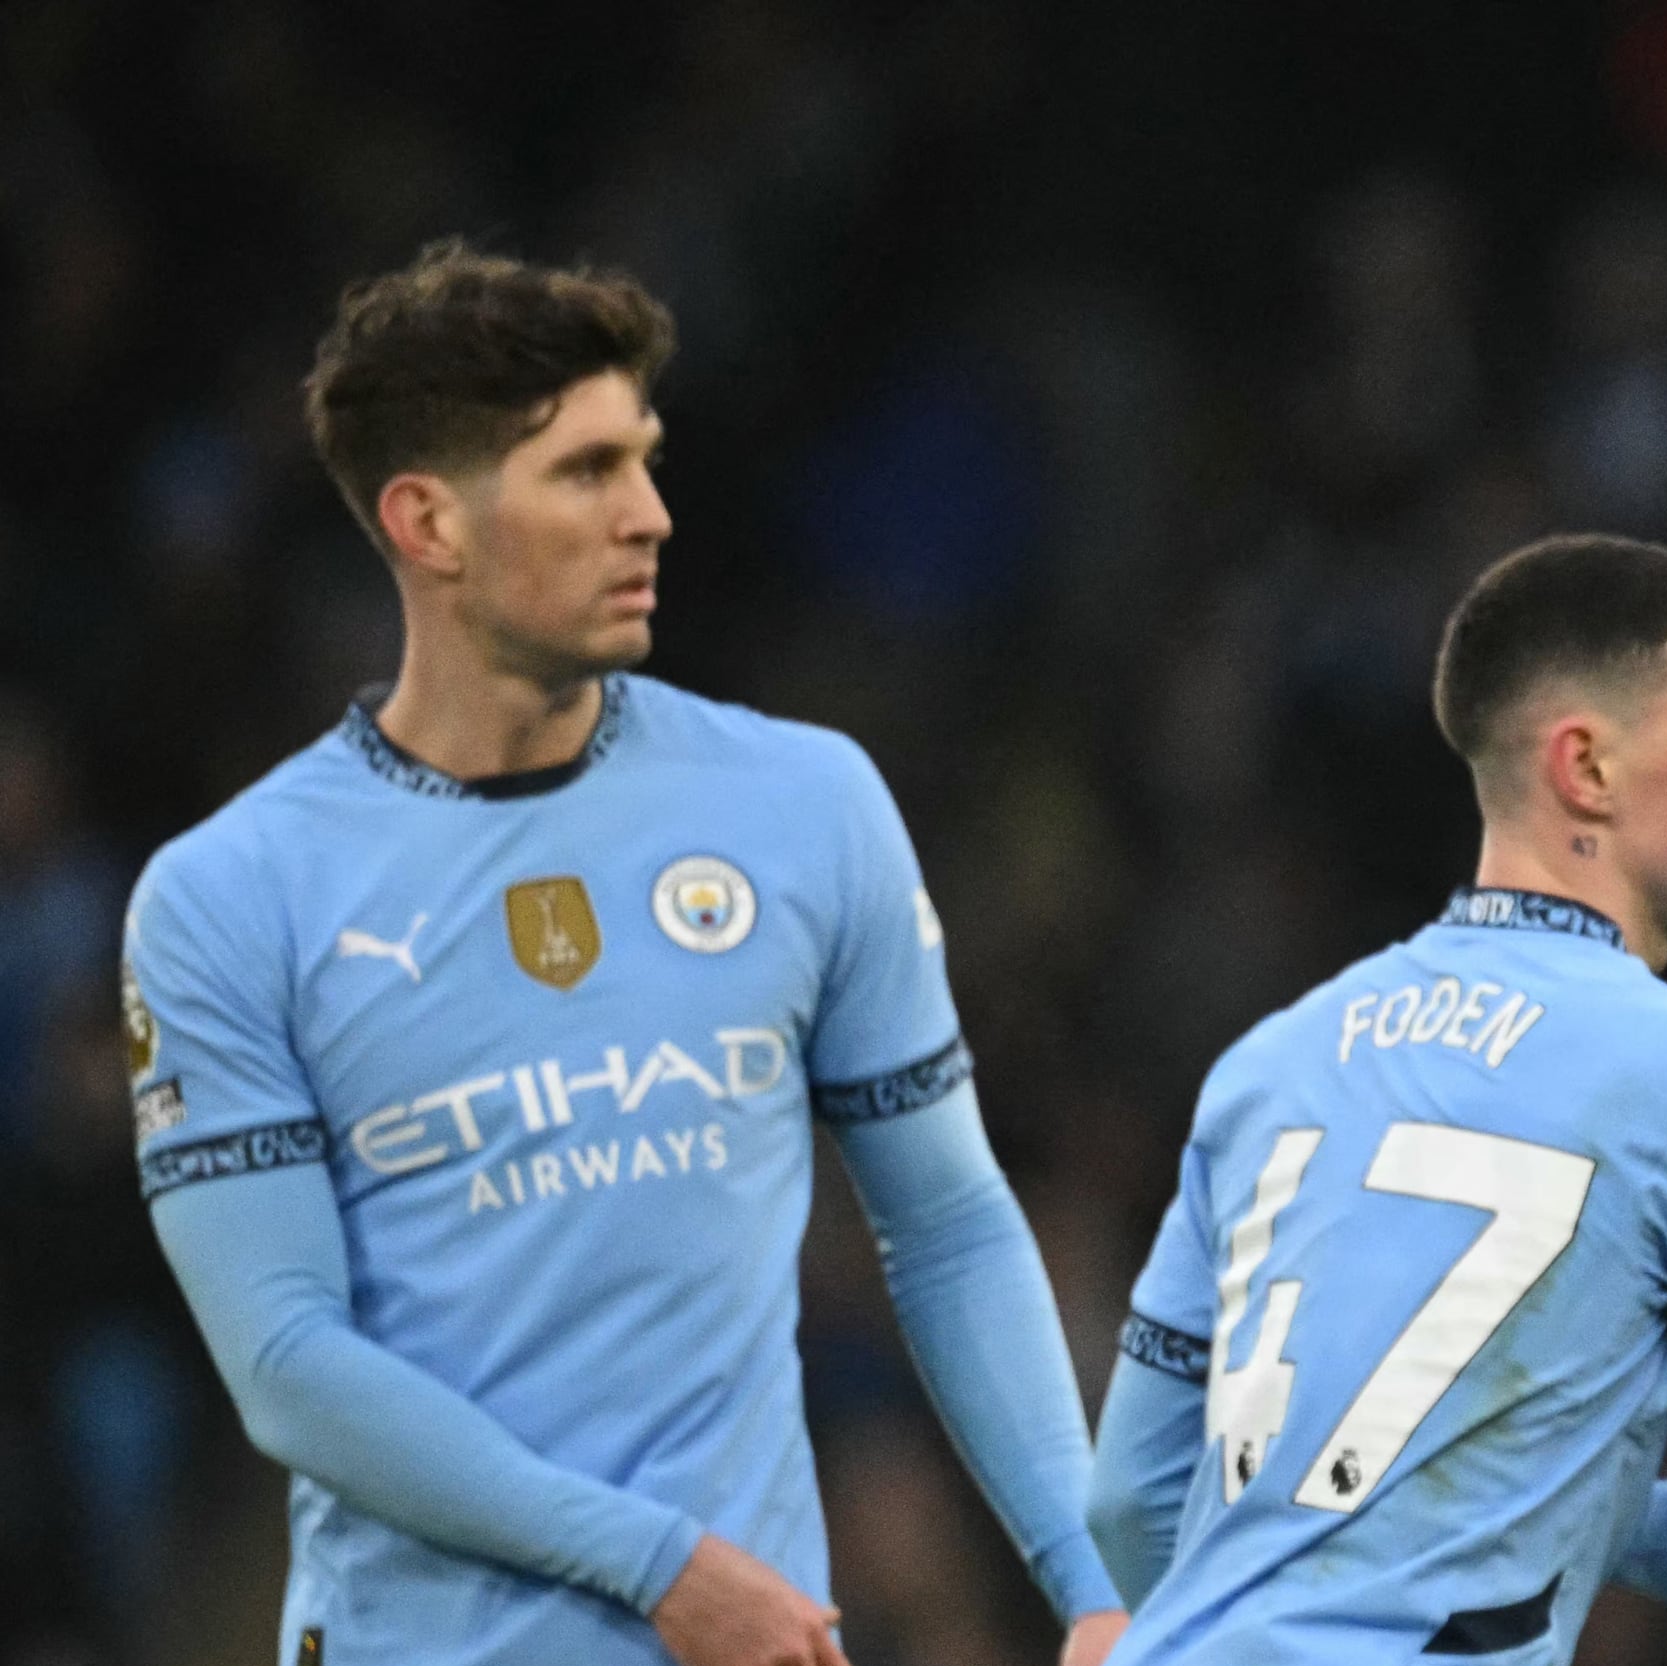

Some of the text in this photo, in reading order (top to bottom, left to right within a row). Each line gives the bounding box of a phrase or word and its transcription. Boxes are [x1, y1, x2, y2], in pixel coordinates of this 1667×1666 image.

[1339, 975, 1545, 1068] FODEN
[352, 1028, 786, 1175] ETIHAD
[469, 1123, 728, 1215] AIRWAYS
[1205, 1121, 1597, 1513] 47
